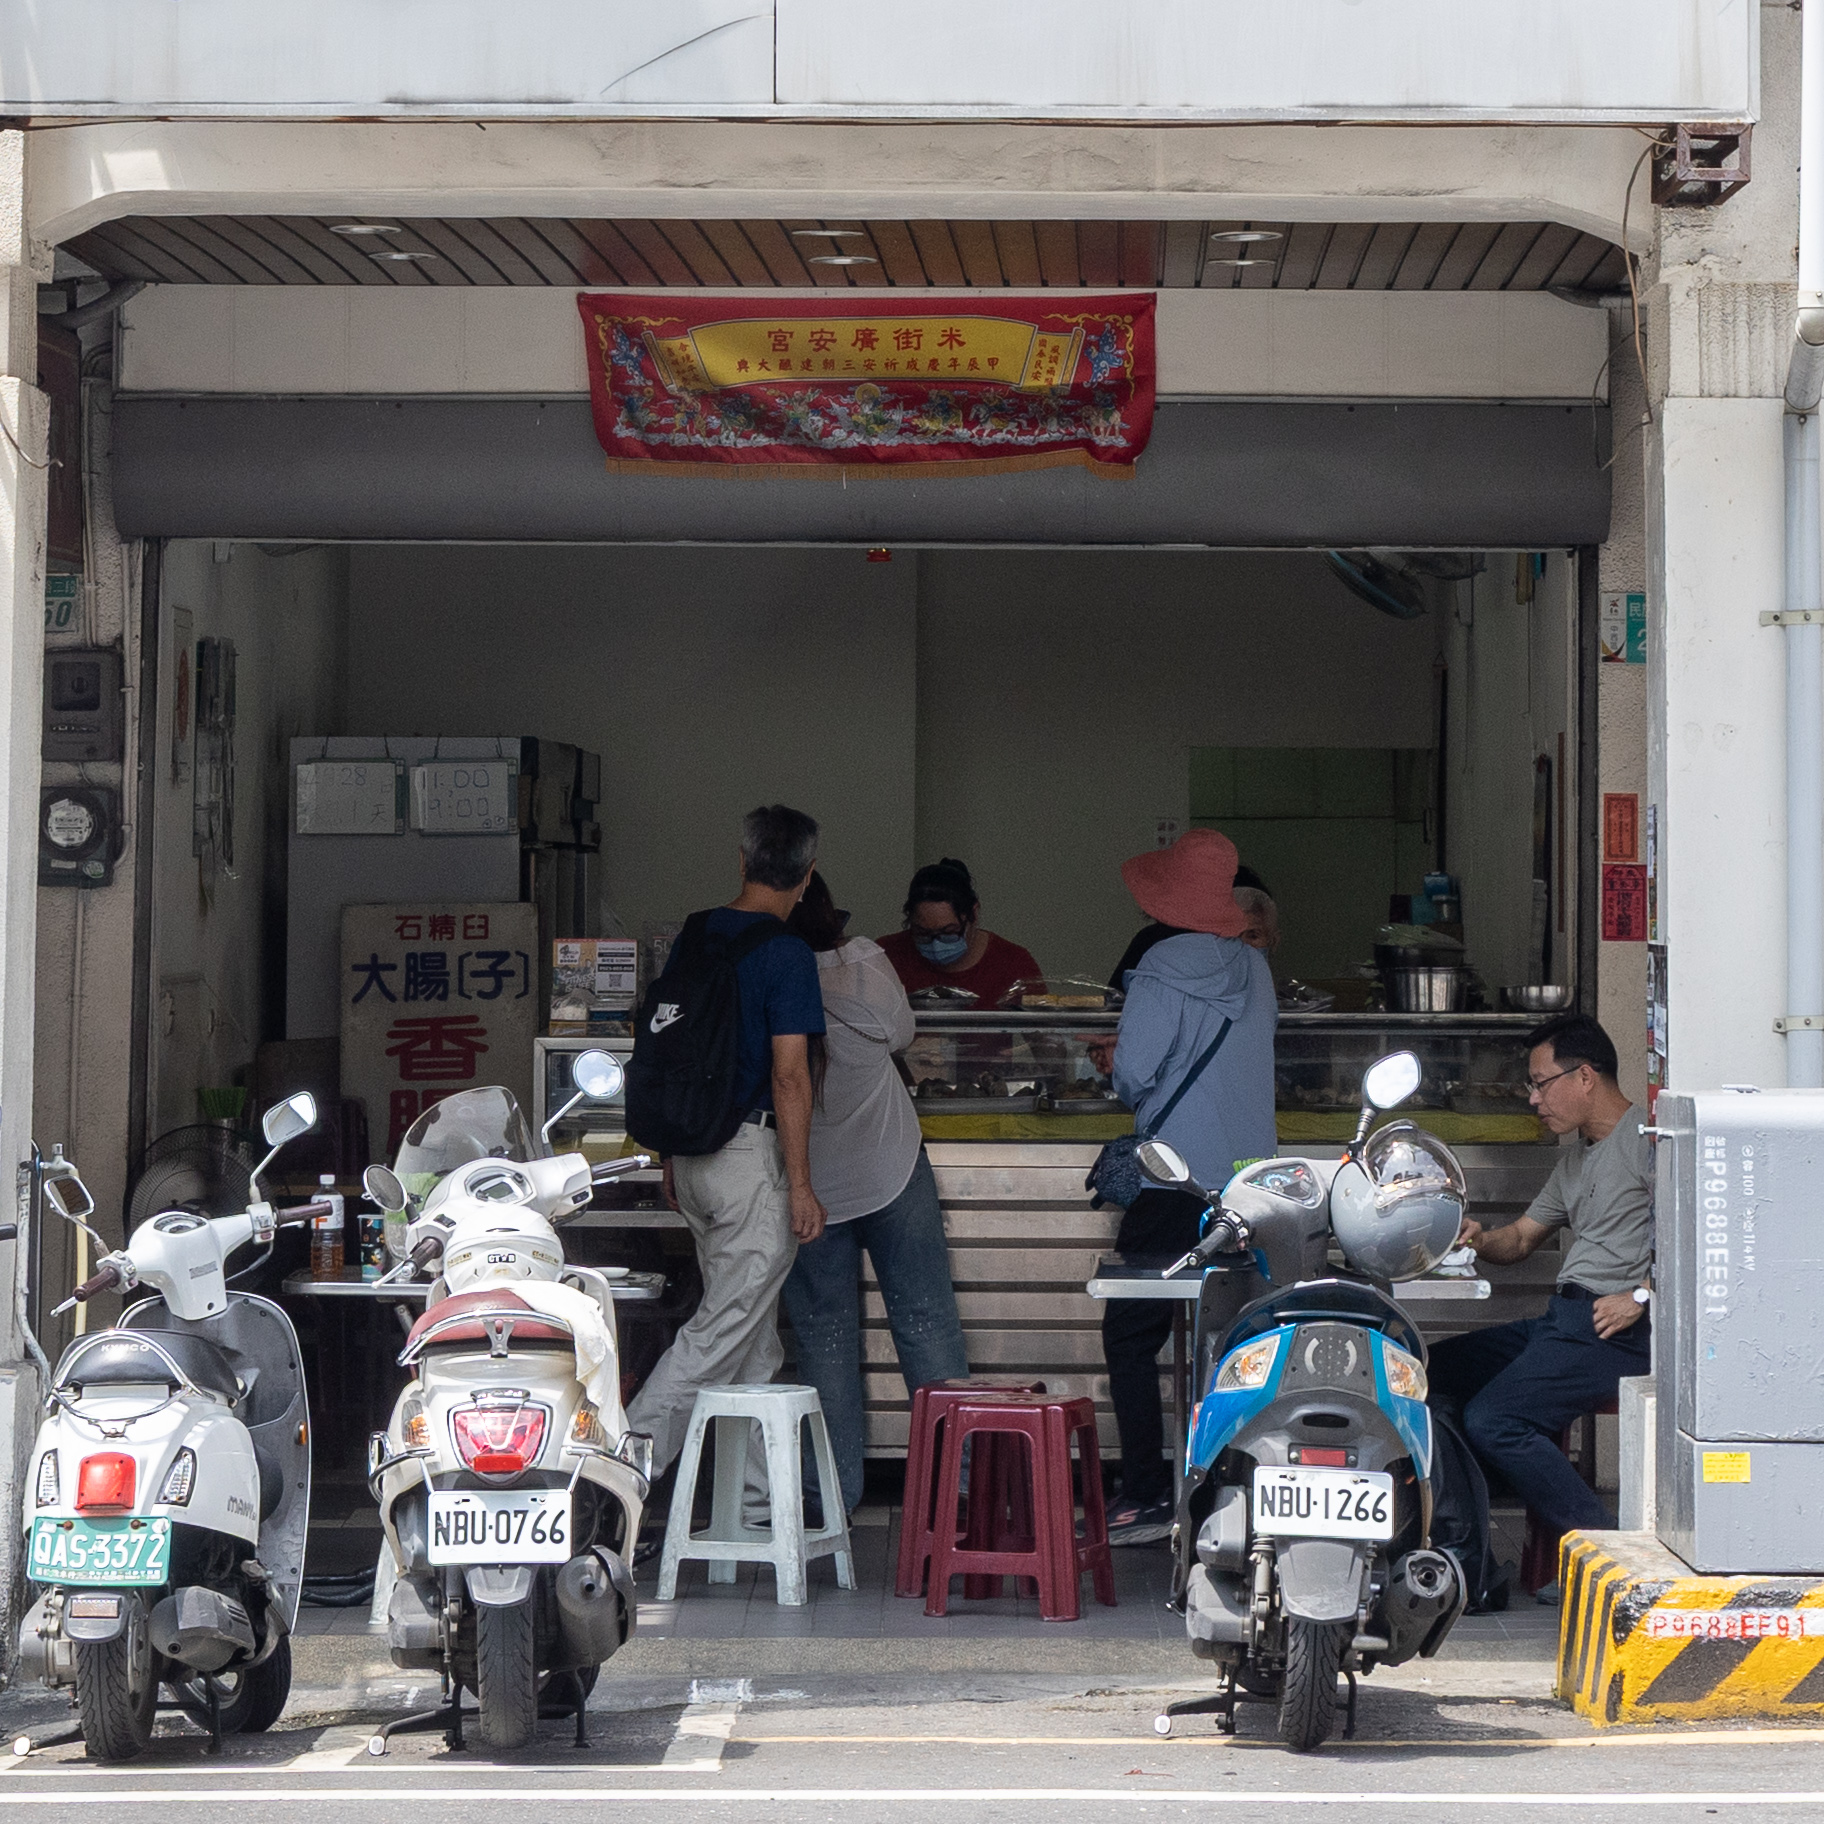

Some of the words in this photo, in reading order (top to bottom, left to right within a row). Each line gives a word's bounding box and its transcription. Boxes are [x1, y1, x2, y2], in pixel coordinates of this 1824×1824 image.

[767, 327, 966, 352] 米街廣安宮
[394, 914, 489, 941] 石精臼
[657, 1003, 680, 1020] NIKE
[101, 1343, 150, 1352] KYMCO
[1259, 1484, 1388, 1524] NBU-1266
[435, 1509, 565, 1546] NBU-0766
[34, 1532, 165, 1569] QAS-3372
